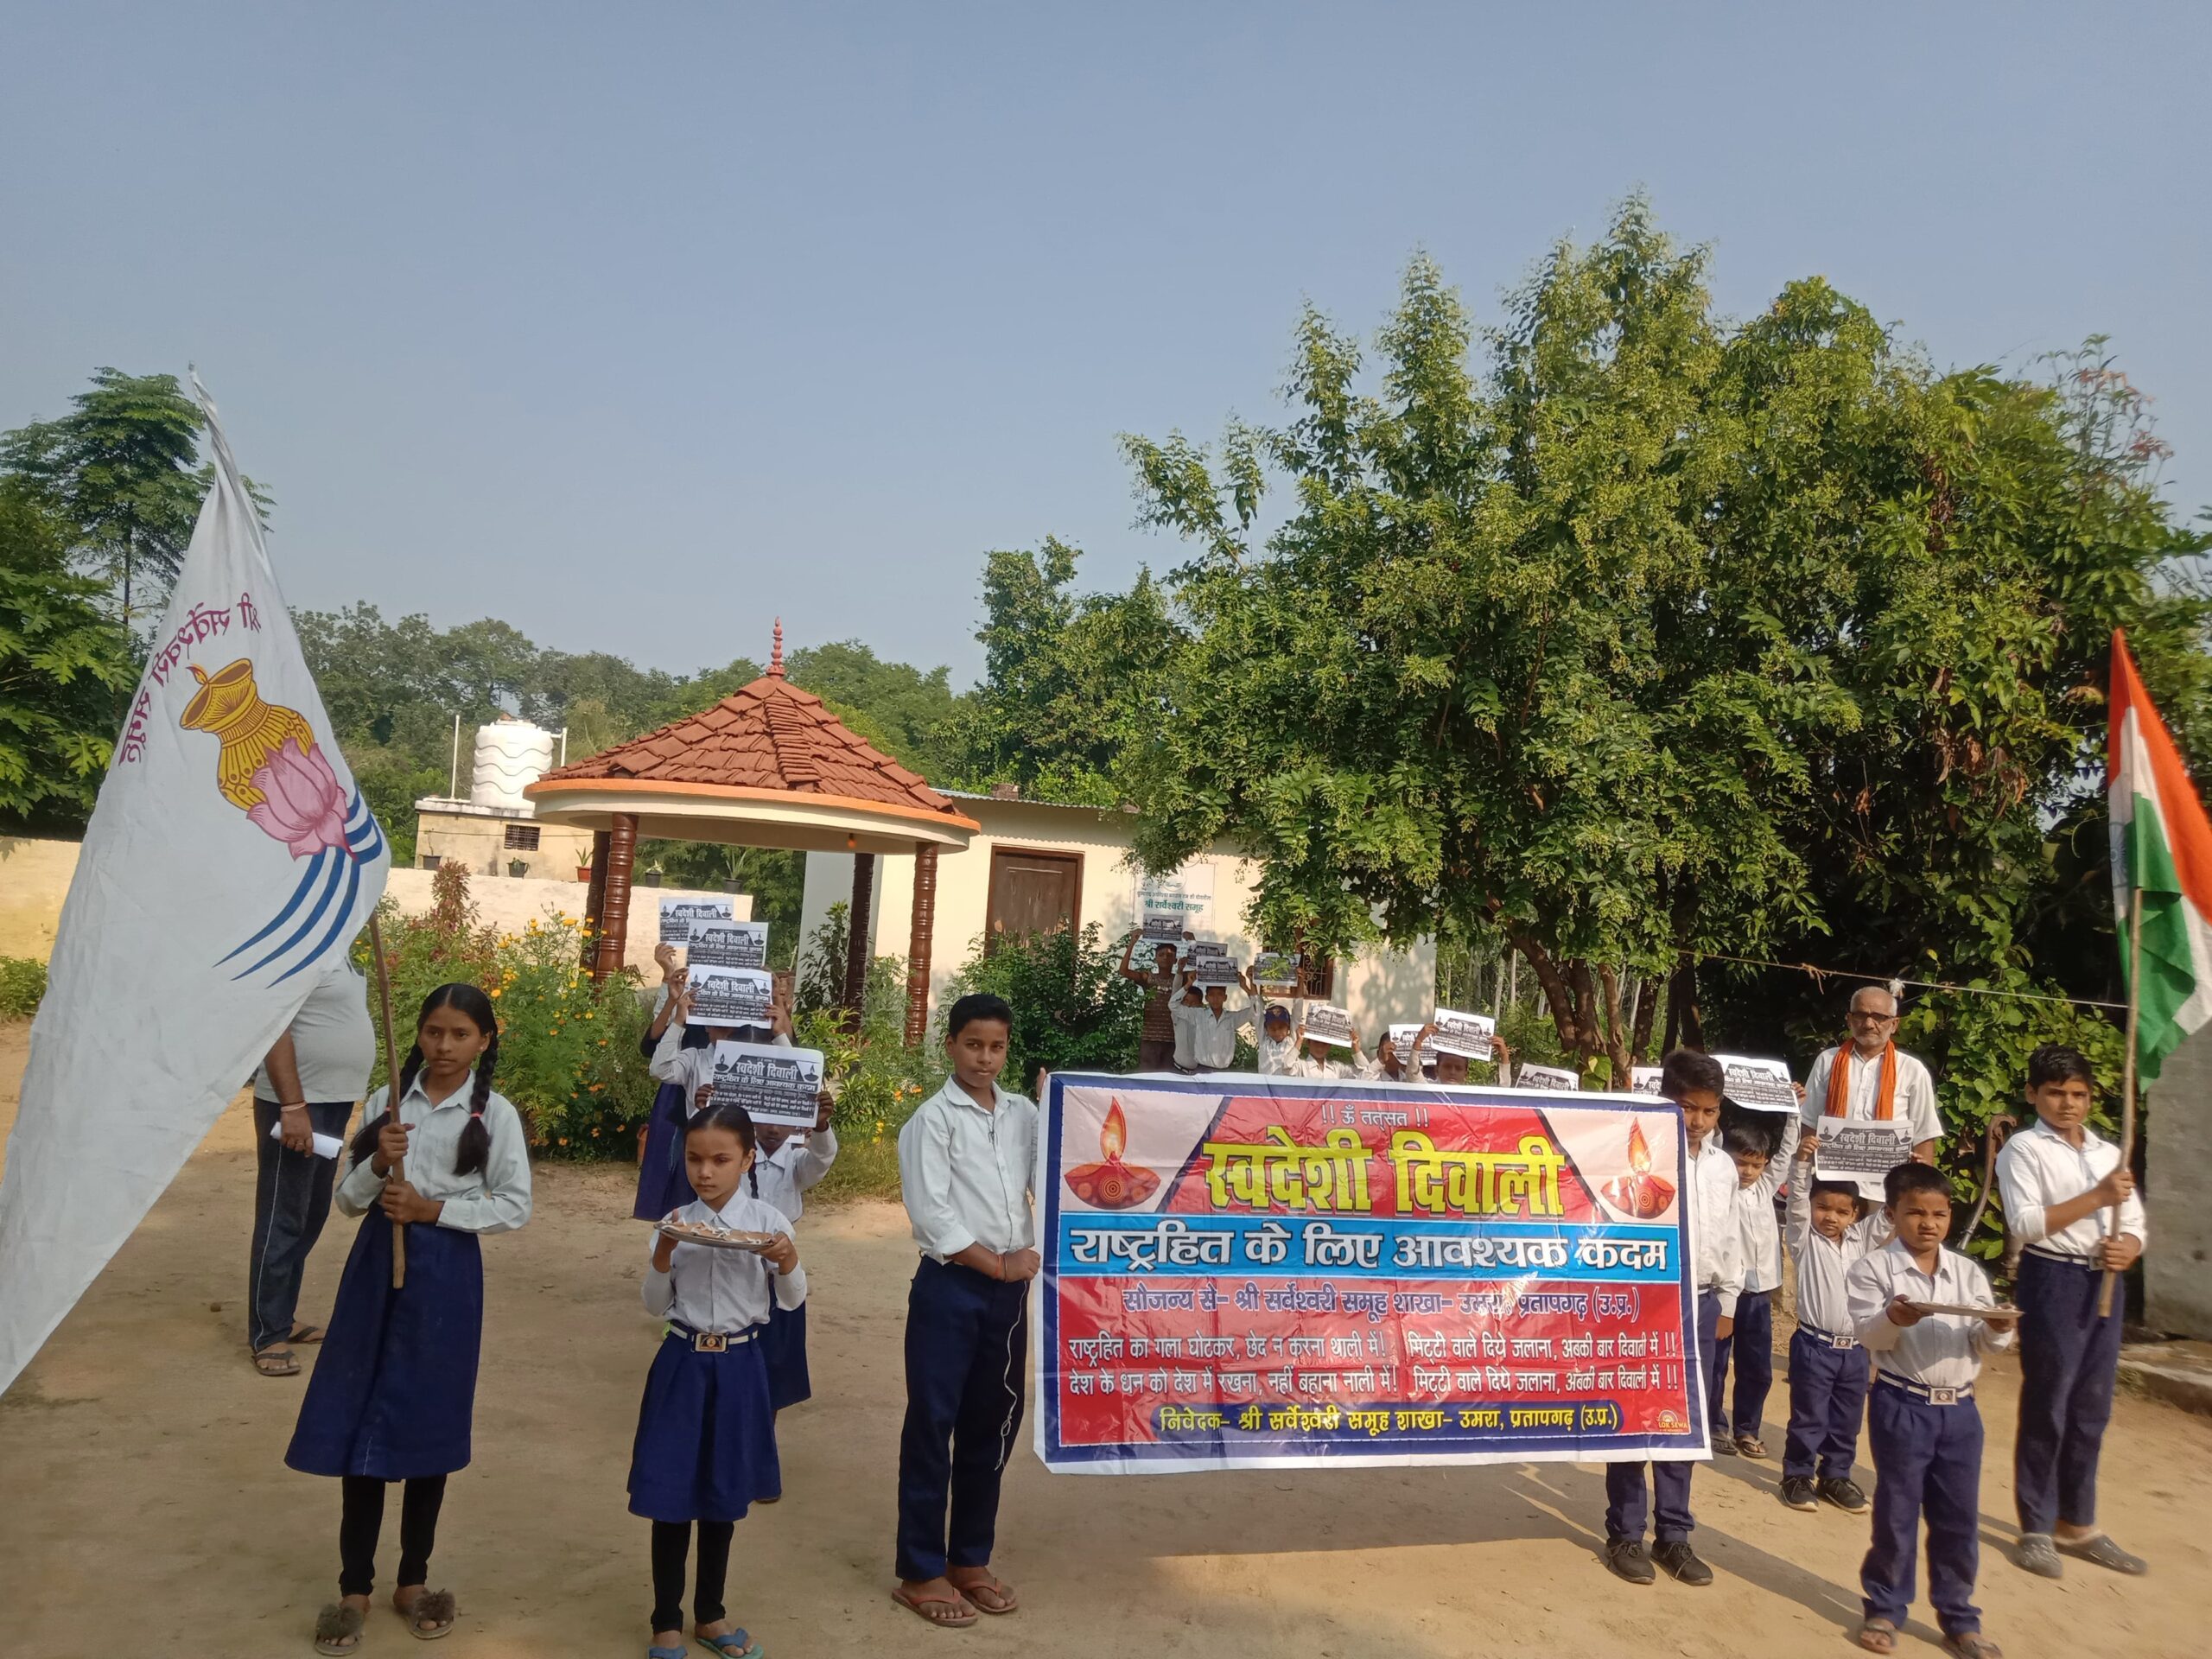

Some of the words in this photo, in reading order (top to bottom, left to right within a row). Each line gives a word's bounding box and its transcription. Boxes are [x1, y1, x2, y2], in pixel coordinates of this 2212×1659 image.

[736, 1060, 766, 1077] स्वदेशी
[767, 1063, 798, 1080] दिवाली
[1648, 1080, 1662, 1091] स्वदे
[1203, 1126, 1373, 1212] स्वदेशी
[1389, 1131, 1566, 1217] दिवाली
[1070, 1220, 1235, 1271] राष्ट्रहित
[1244, 1222, 1291, 1264] के
[1302, 1223, 1383, 1268] लिए
[1393, 1236, 1569, 1269] आवश्यक
[1579, 1238, 1669, 1271] कदम
[1122, 1281, 1194, 1312] सौजन्य
[1235, 1281, 1260, 1312] श्री
[1263, 1281, 1337, 1313] सर्वेश्वरी
[1341, 1290, 1389, 1324] समूह
[1516, 1293, 1588, 1322] प्रतापगढ़
[1592, 1286, 1640, 1323] (उ.प्र.)
[1068, 1330, 1124, 1367] राष्ट्रहित
[1129, 1338, 1149, 1359] का
[1154, 1338, 1182, 1359] गला
[1187, 1329, 1241, 1361] घोटकर,
[1245, 1330, 1268, 1359] छेद
[1272, 1338, 1283, 1357] न
[1288, 1338, 1325, 1357] करना
[1331, 1331, 1363, 1357] थाली
[1451, 1331, 1478, 1358] वाले
[1482, 1331, 1506, 1359] दिये
[1510, 1338, 1558, 1361] जलाना,
[1561, 1332, 1593, 1359] अबकी
[1597, 1338, 1614, 1358] बार
[1649, 1332, 1659, 1357] में
[1069, 1367, 1095, 1395] देश
[1100, 1366, 1115, 1395] के
[1120, 1373, 1143, 1395] धन
[1148, 1366, 1168, 1394] को
[1173, 1365, 1197, 1395] देश
[1202, 1365, 1214, 1394] में
[1217, 1372, 1262, 1396] रखना,
[1268, 1364, 1294, 1395] नहीं
[1298, 1372, 1338, 1395] बहाना
[1343, 1365, 1375, 1393] नाली
[1456, 1366, 1482, 1393] वाले
[1486, 1365, 1511, 1393] दिये
[1515, 1372, 1560, 1395] जलाना,
[1566, 1365, 1595, 1392] अबकी
[1598, 1371, 1614, 1391] बार
[1618, 1365, 1647, 1390] दिवाली
[1651, 1363, 1661, 1389] में
[1238, 1406, 1263, 1432] श्री
[1268, 1404, 1341, 1432] सर्वेश्वरी
[1346, 1411, 1390, 1437] समूह
[1510, 1408, 1575, 1432] प्रतापगढ़
[1580, 1404, 1618, 1432] (उ.प्र.)
